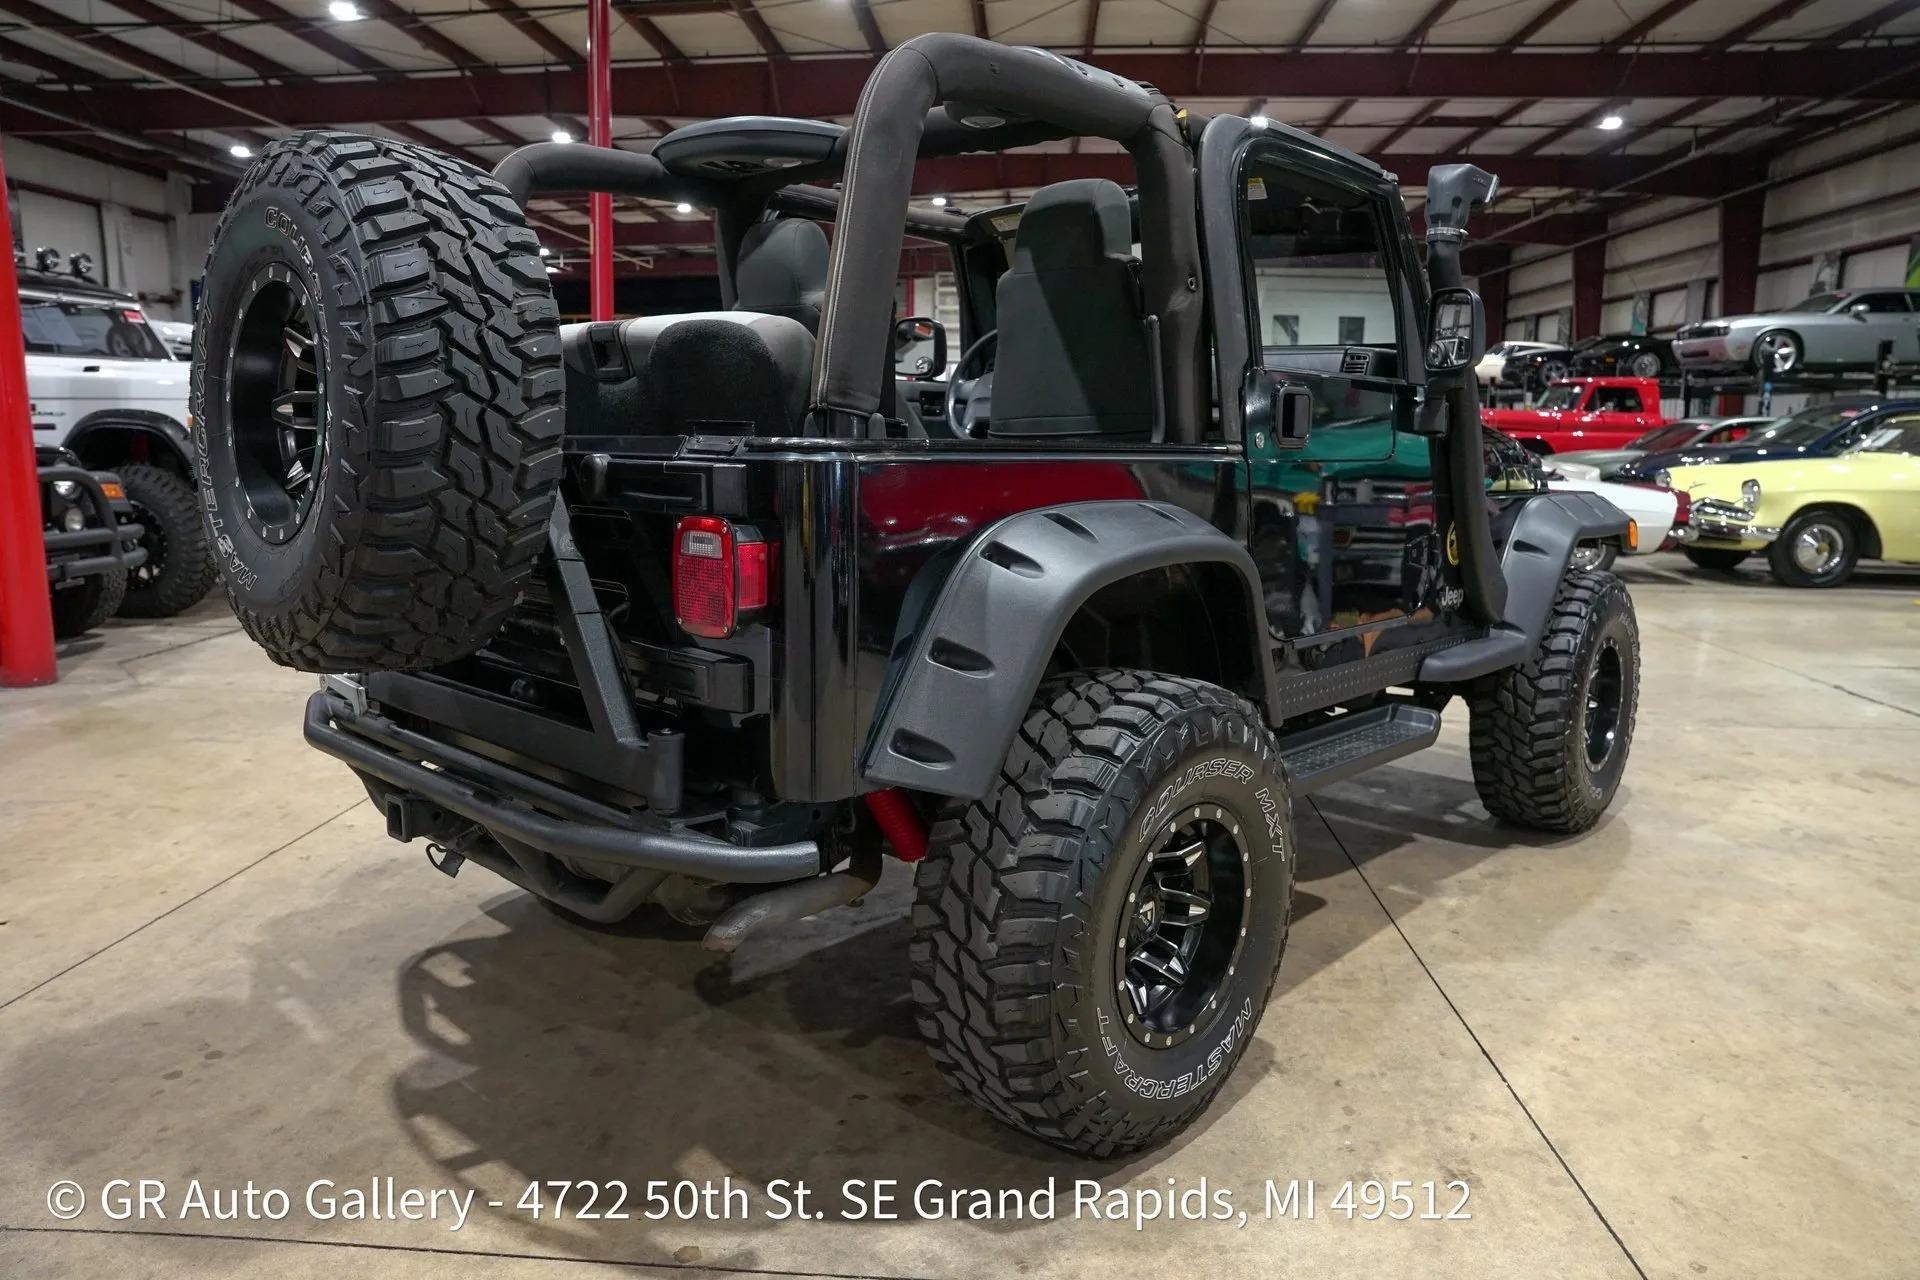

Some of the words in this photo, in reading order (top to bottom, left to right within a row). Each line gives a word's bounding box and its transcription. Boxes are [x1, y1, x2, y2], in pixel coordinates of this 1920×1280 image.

[195, 288, 259, 592] MASTERCRAFT
[1441, 586, 1464, 608] Jeep
[1139, 757, 1254, 843] COURSER
[1254, 787, 1286, 862] MXT
[1096, 996, 1253, 1101] MASTERCRAFT
